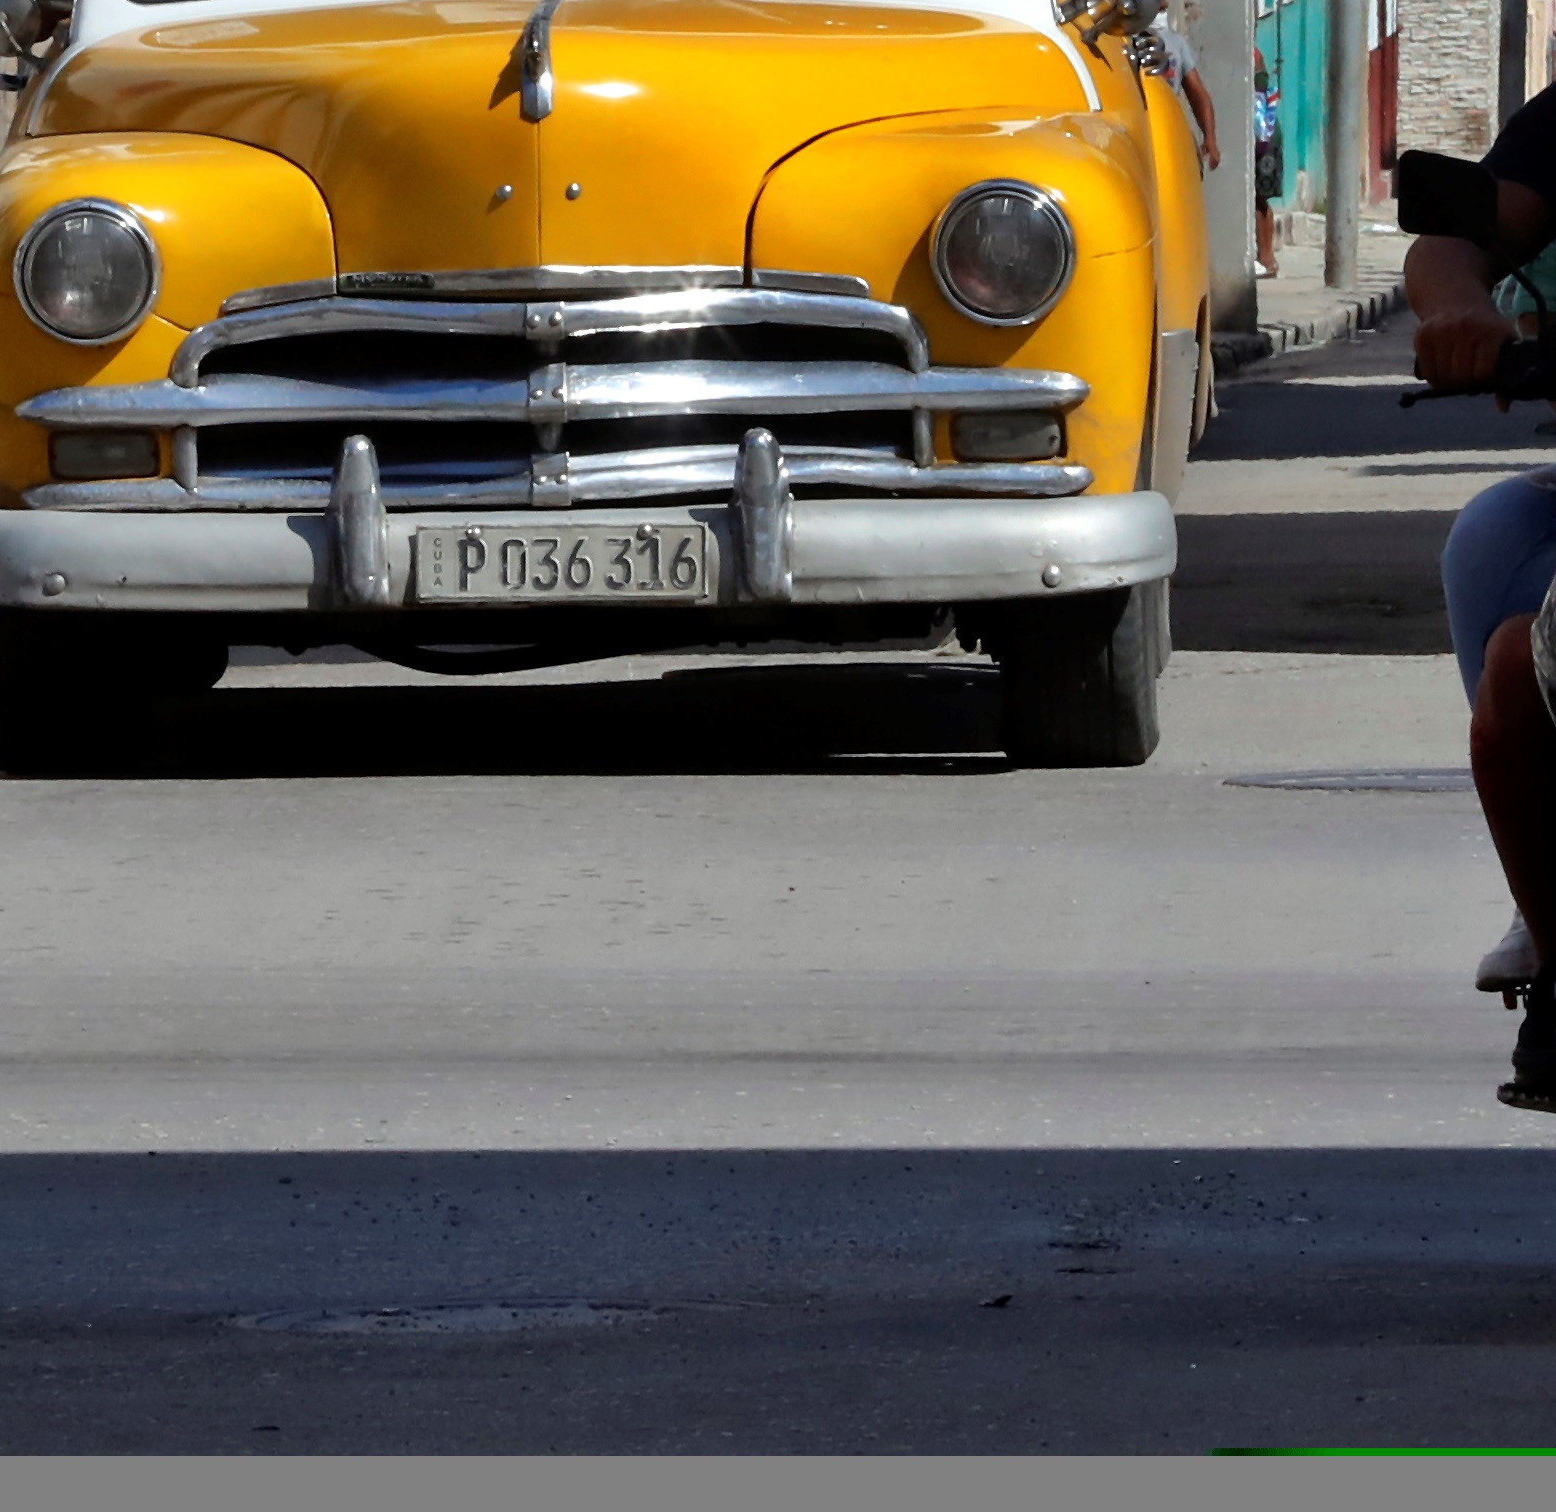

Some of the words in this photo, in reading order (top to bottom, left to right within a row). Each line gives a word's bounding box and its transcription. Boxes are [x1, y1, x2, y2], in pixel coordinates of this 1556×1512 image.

[432, 536, 444, 588] CUBA
[457, 536, 488, 591] P
[500, 536, 594, 591] 036
[604, 536, 699, 591] 316
